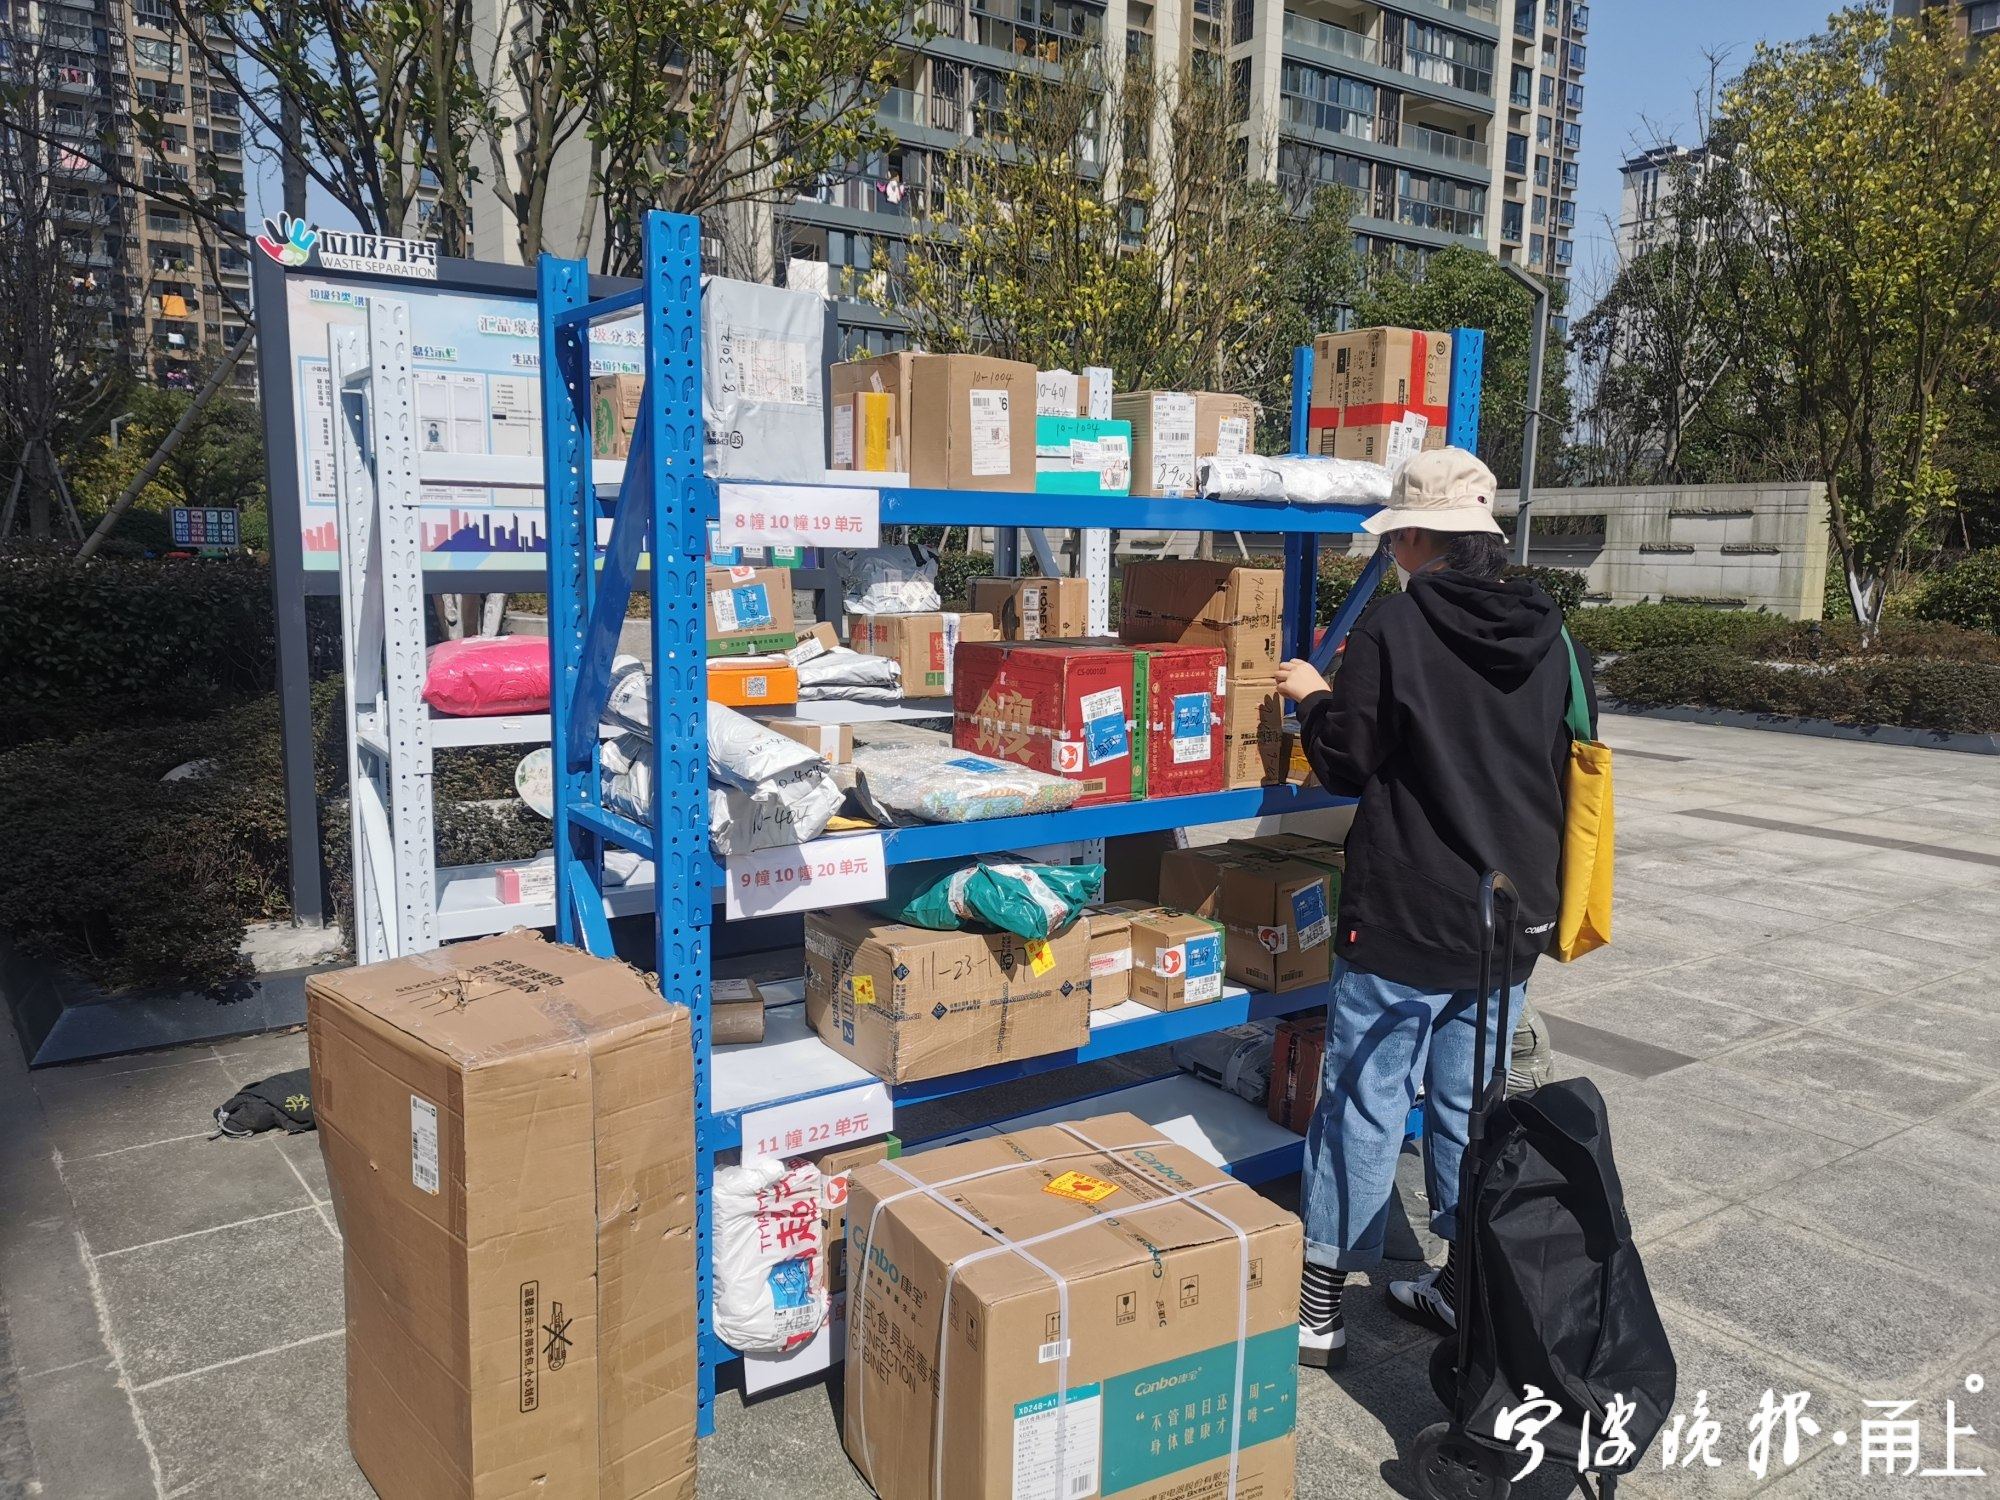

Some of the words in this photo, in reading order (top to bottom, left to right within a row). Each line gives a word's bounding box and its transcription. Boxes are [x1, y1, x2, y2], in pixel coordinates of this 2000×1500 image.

[319, 231, 436, 265] 垃圾分类
[321, 256, 362, 270] WASTE
[366, 260, 436, 279] SEPARATION
[972, 371, 1014, 388] 10-1004
[1040, 585, 1048, 634] HONEY
[1134, 1375, 1178, 1397] Canbo
